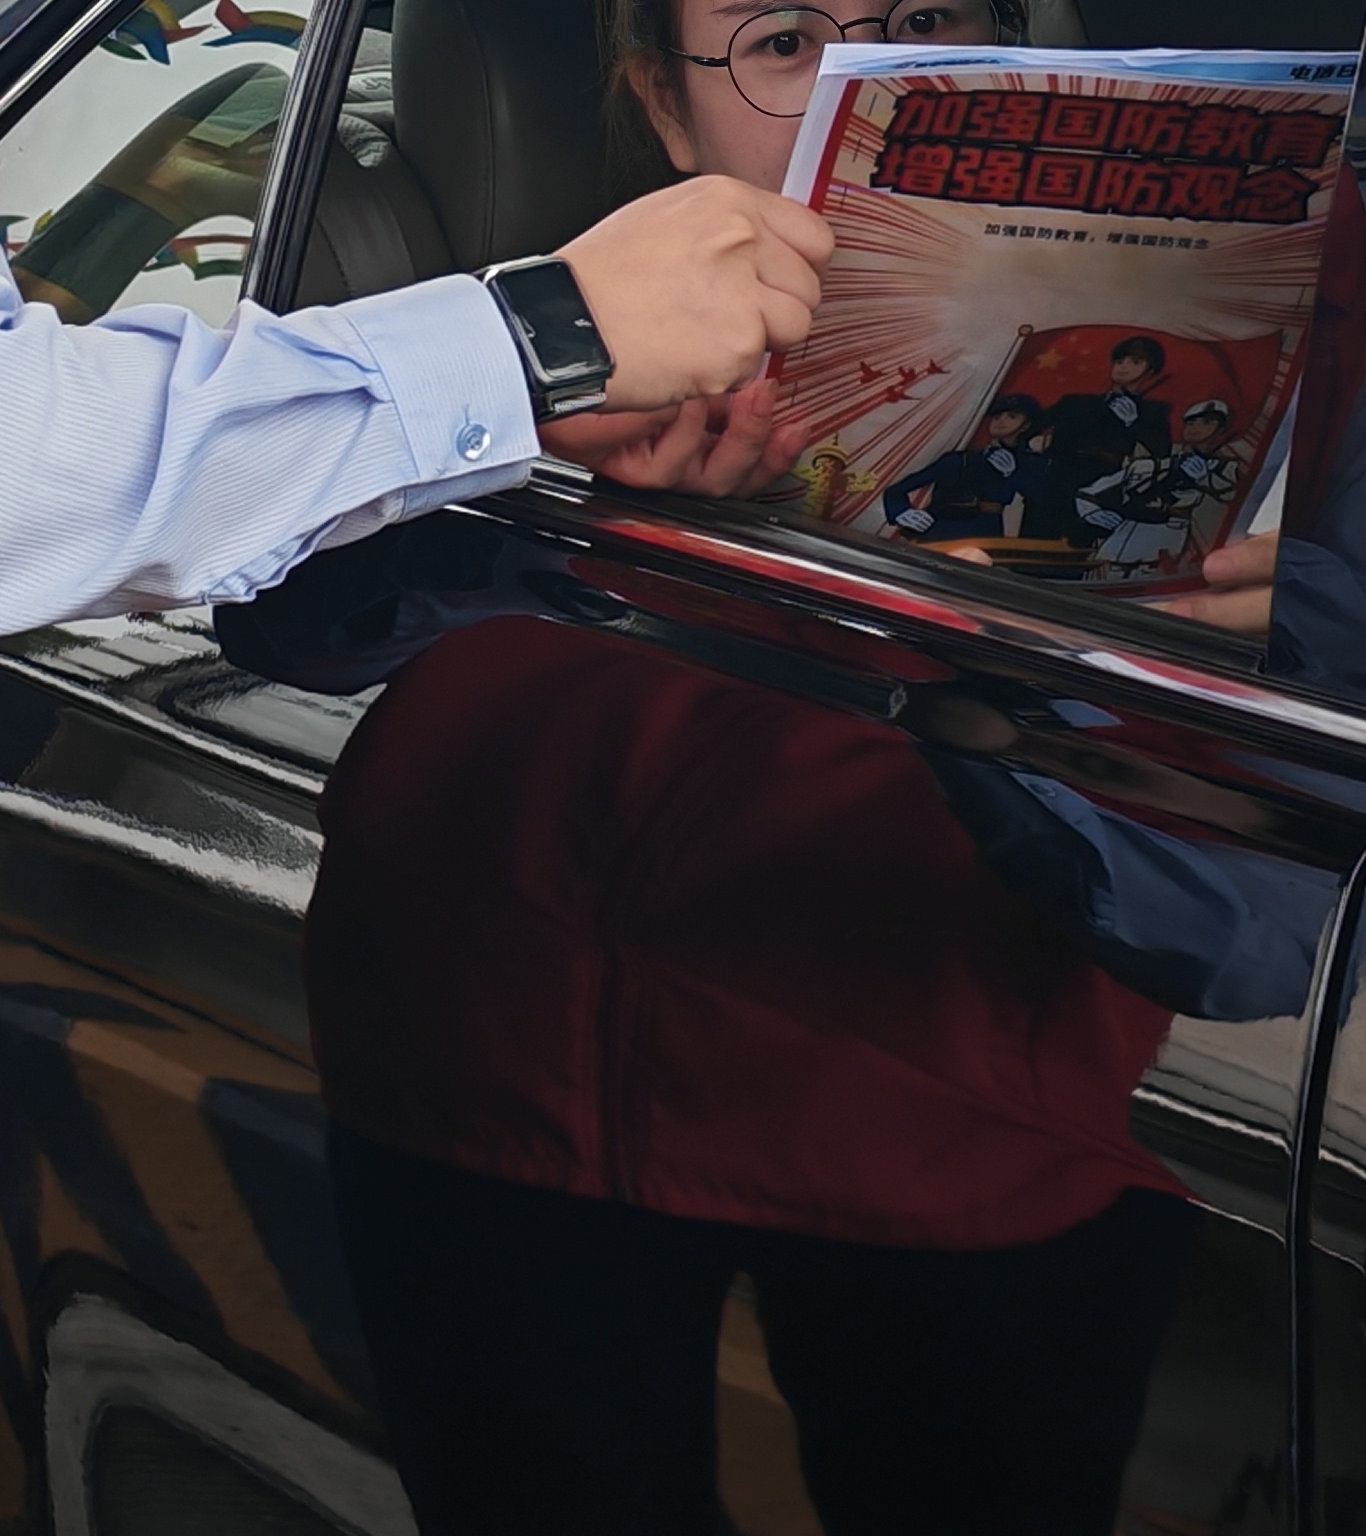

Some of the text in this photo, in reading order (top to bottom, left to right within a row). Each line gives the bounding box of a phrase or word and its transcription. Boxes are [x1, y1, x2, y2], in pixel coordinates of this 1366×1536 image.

[890, 90, 1345, 164] 加强国防教育
[875, 147, 1315, 221] 增强国防观念
